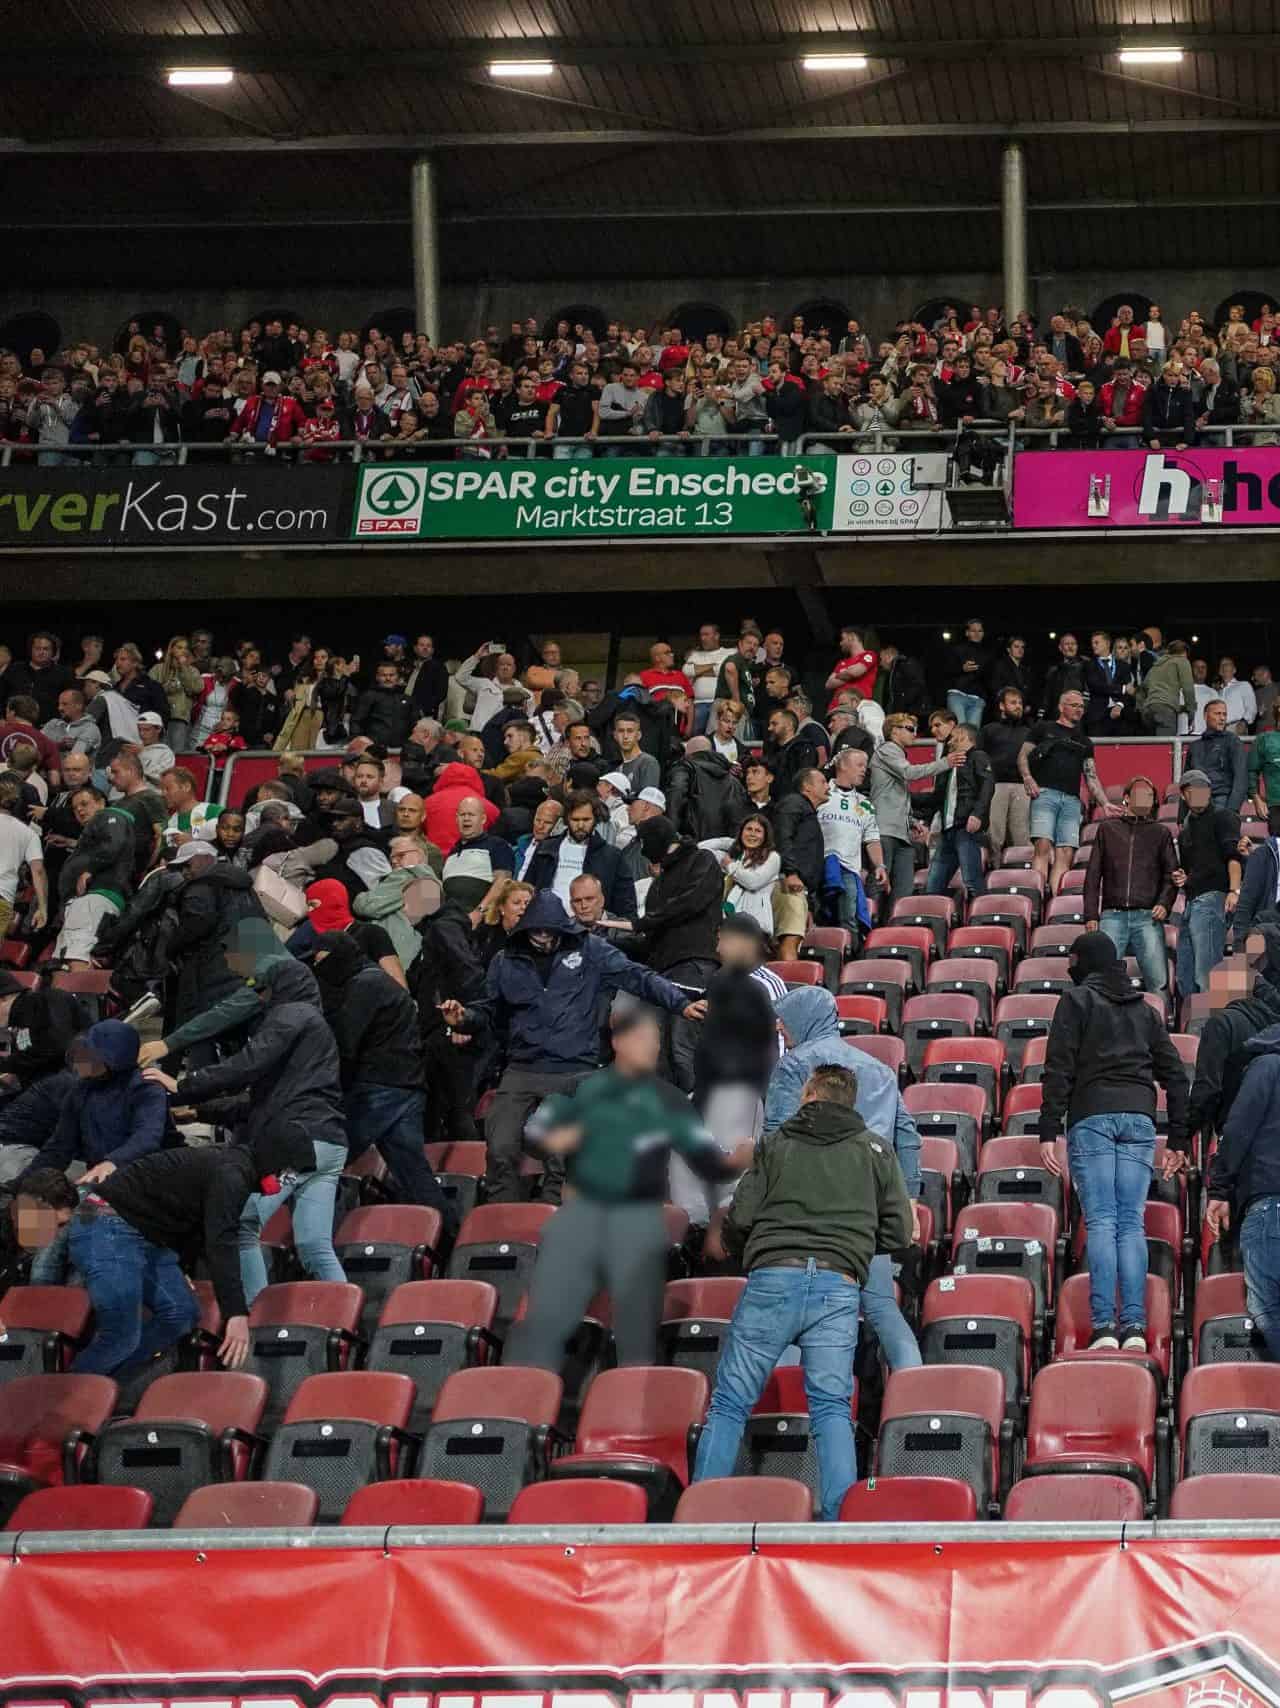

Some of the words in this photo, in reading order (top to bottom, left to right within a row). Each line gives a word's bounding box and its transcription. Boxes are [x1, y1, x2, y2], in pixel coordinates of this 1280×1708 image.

[428, 471, 537, 501] SPAR
[544, 467, 621, 504] city
[516, 503, 687, 529] Marktstraat
[695, 502, 733, 526] 13
[360, 520, 419, 531] SPAR
[840, 799, 849, 810] 6
